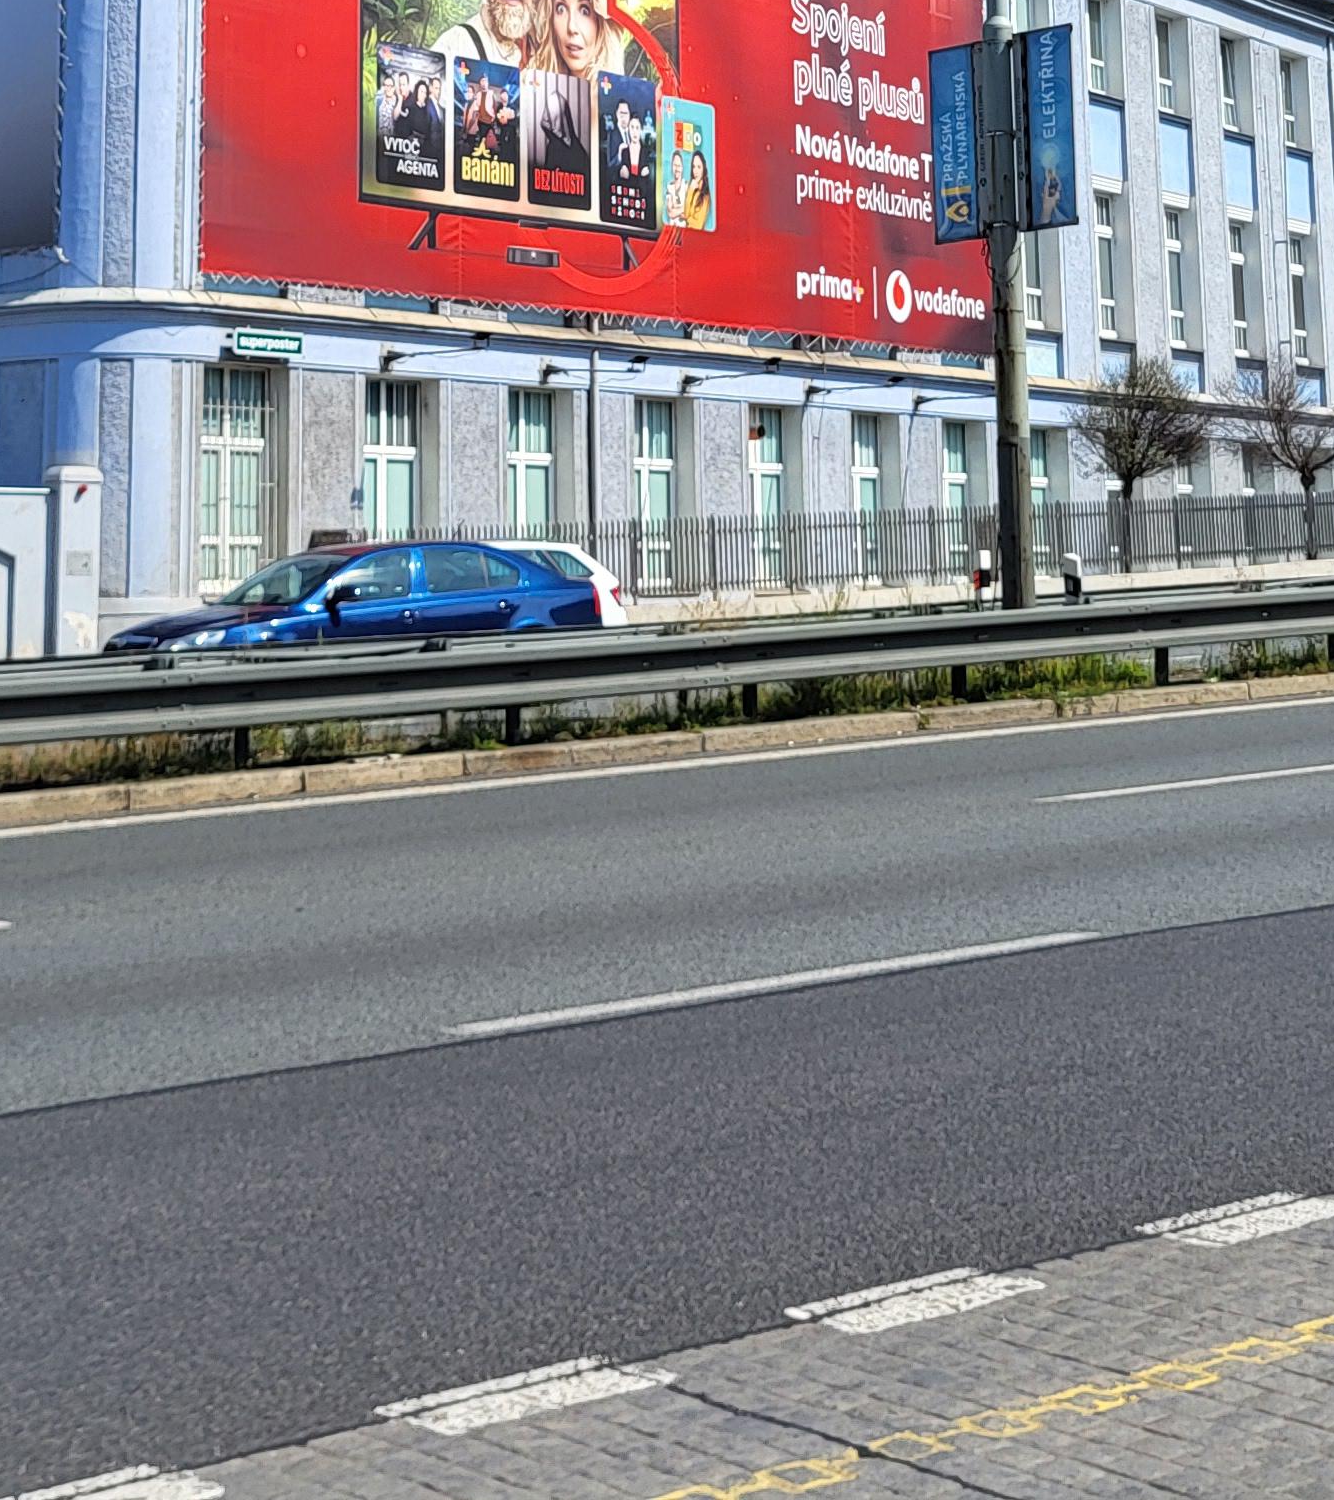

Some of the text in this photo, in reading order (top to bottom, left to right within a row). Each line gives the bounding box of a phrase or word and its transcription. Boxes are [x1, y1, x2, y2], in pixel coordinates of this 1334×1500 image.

[793, 53, 925, 125] plné plusů
[1038, 31, 1056, 140] ELEKTŘINA
[384, 136, 420, 155] VYTOČ
[795, 124, 933, 183] Nová Vodafone T
[396, 158, 439, 178] AGENTA
[534, 167, 585, 196] BEZ LÍTOSTI
[796, 170, 933, 222] prima+ exkluzivně
[913, 286, 986, 321] vodafone
[239, 336, 300, 351] superposter
